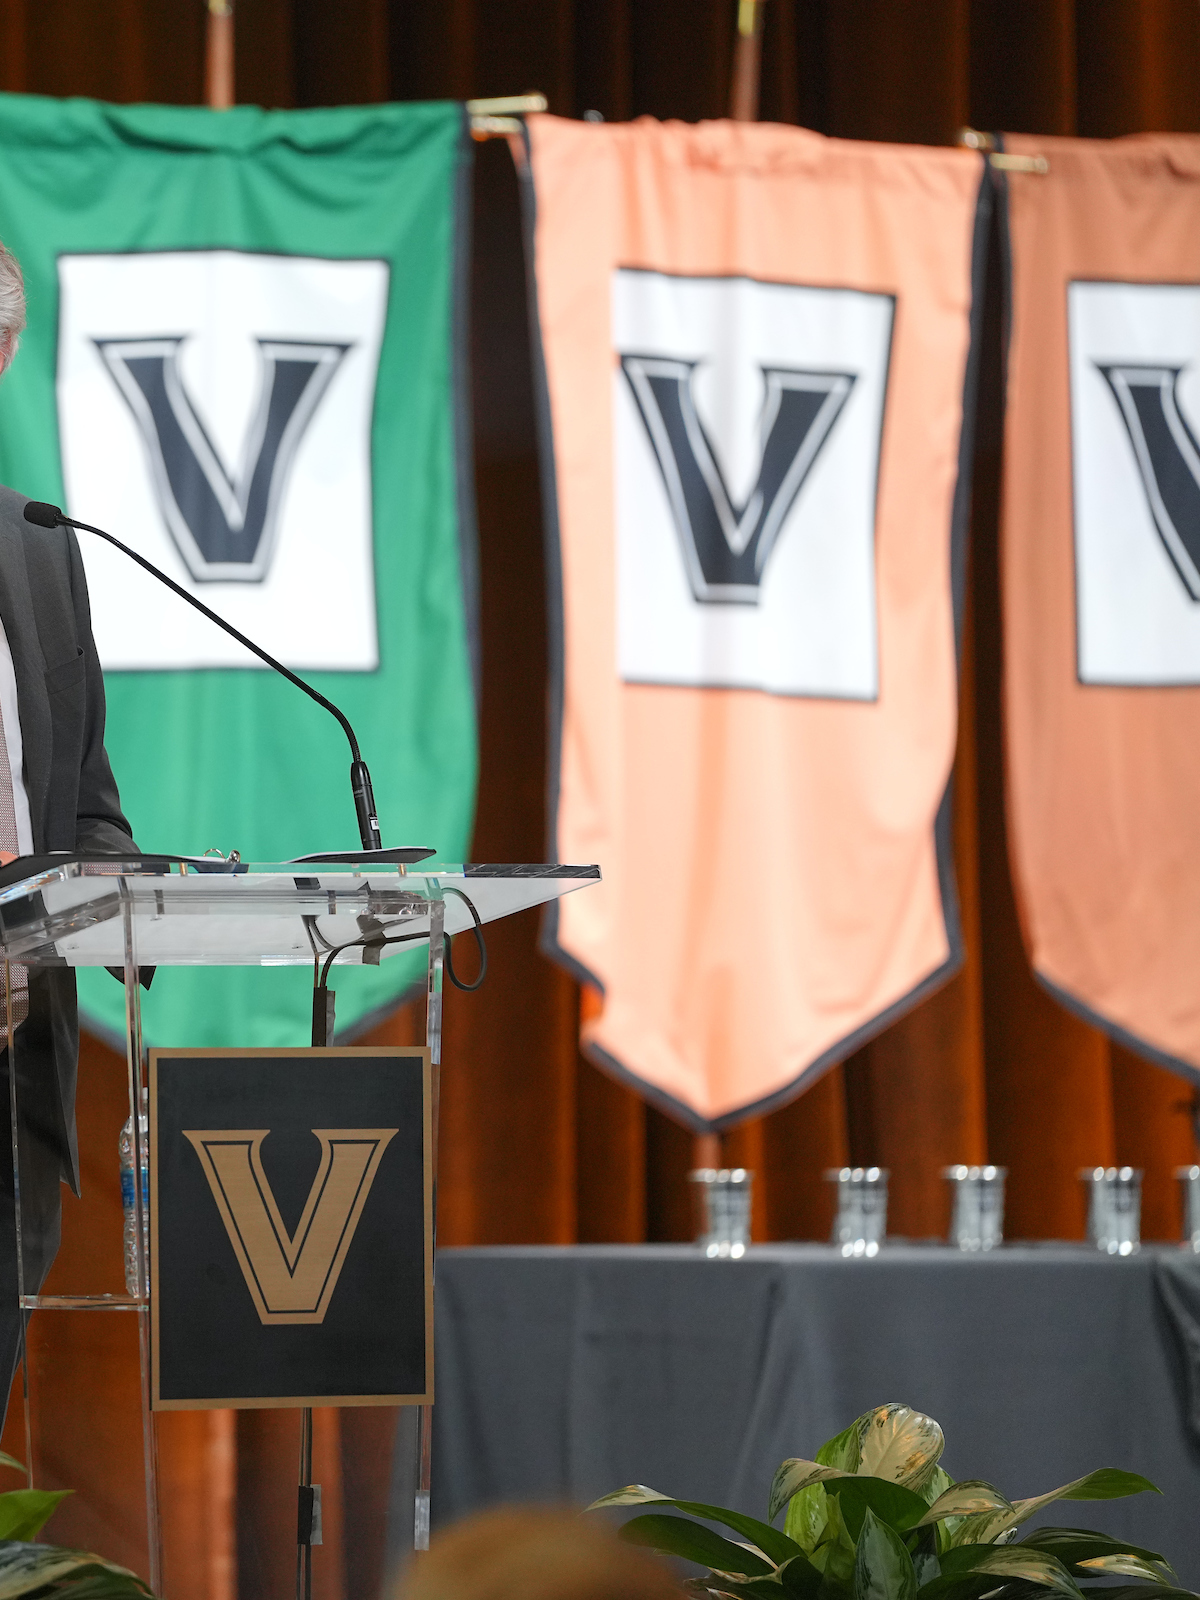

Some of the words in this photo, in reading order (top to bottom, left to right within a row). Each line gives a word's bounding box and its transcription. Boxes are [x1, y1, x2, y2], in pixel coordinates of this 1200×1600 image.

[91, 335, 353, 584] V
[620, 355, 859, 606] V
[182, 1129, 399, 1324] V
